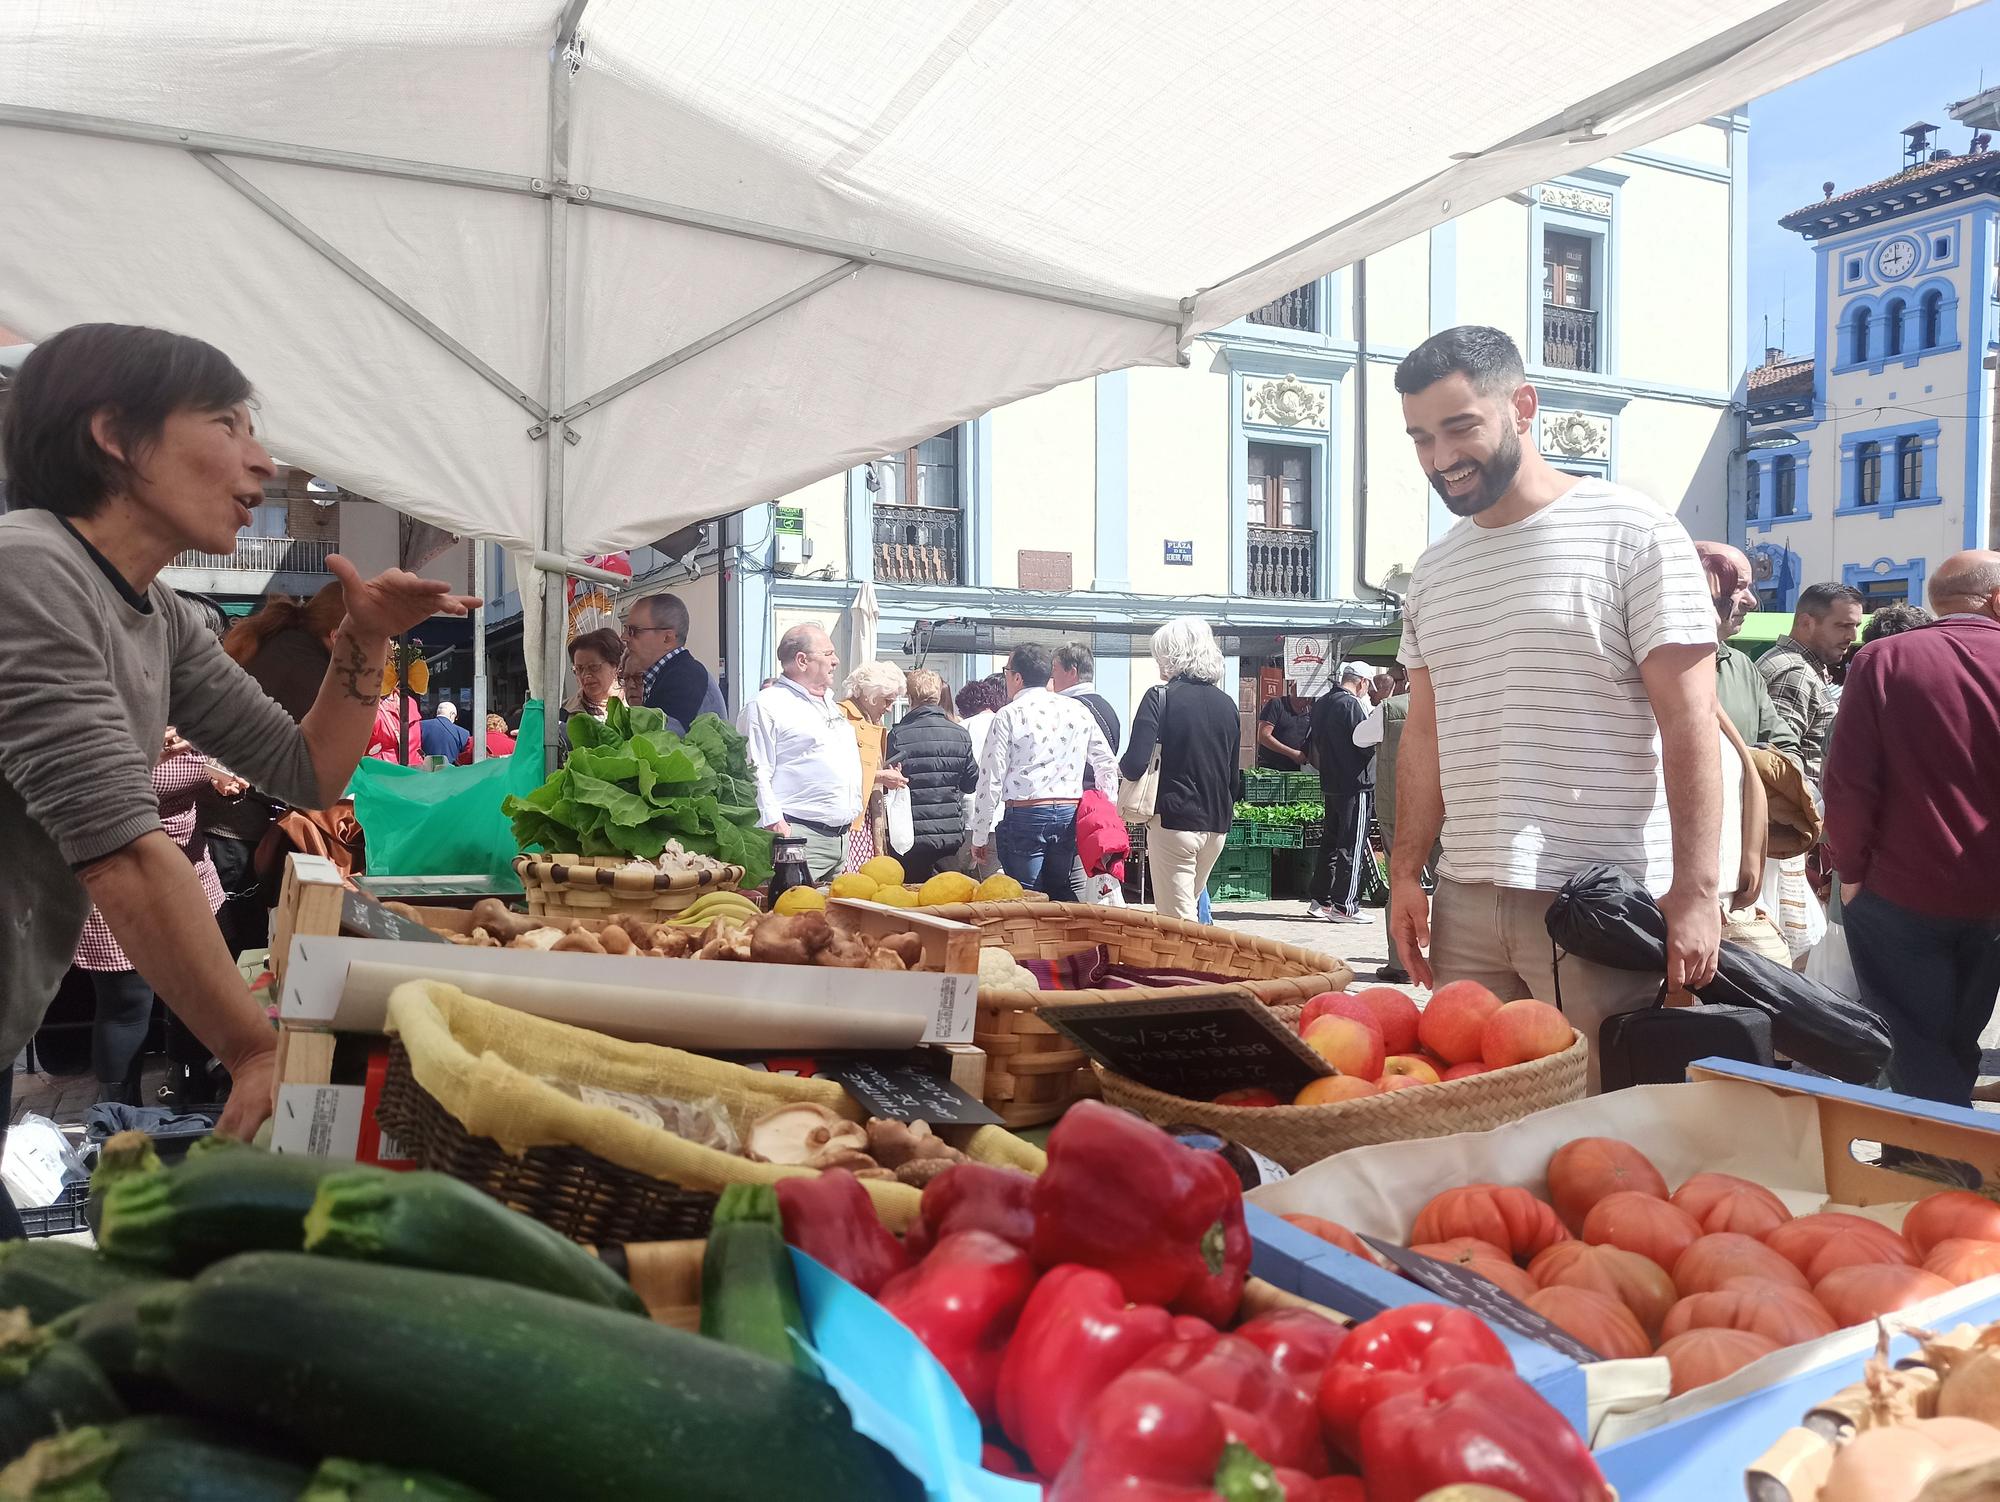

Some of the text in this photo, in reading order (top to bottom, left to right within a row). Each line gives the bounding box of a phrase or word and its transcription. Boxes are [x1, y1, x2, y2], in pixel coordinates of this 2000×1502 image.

[1122, 1042, 1273, 1062] BERENJENA
[842, 1071, 910, 1117] SHIITAKE
[894, 1092, 921, 1107] DE
